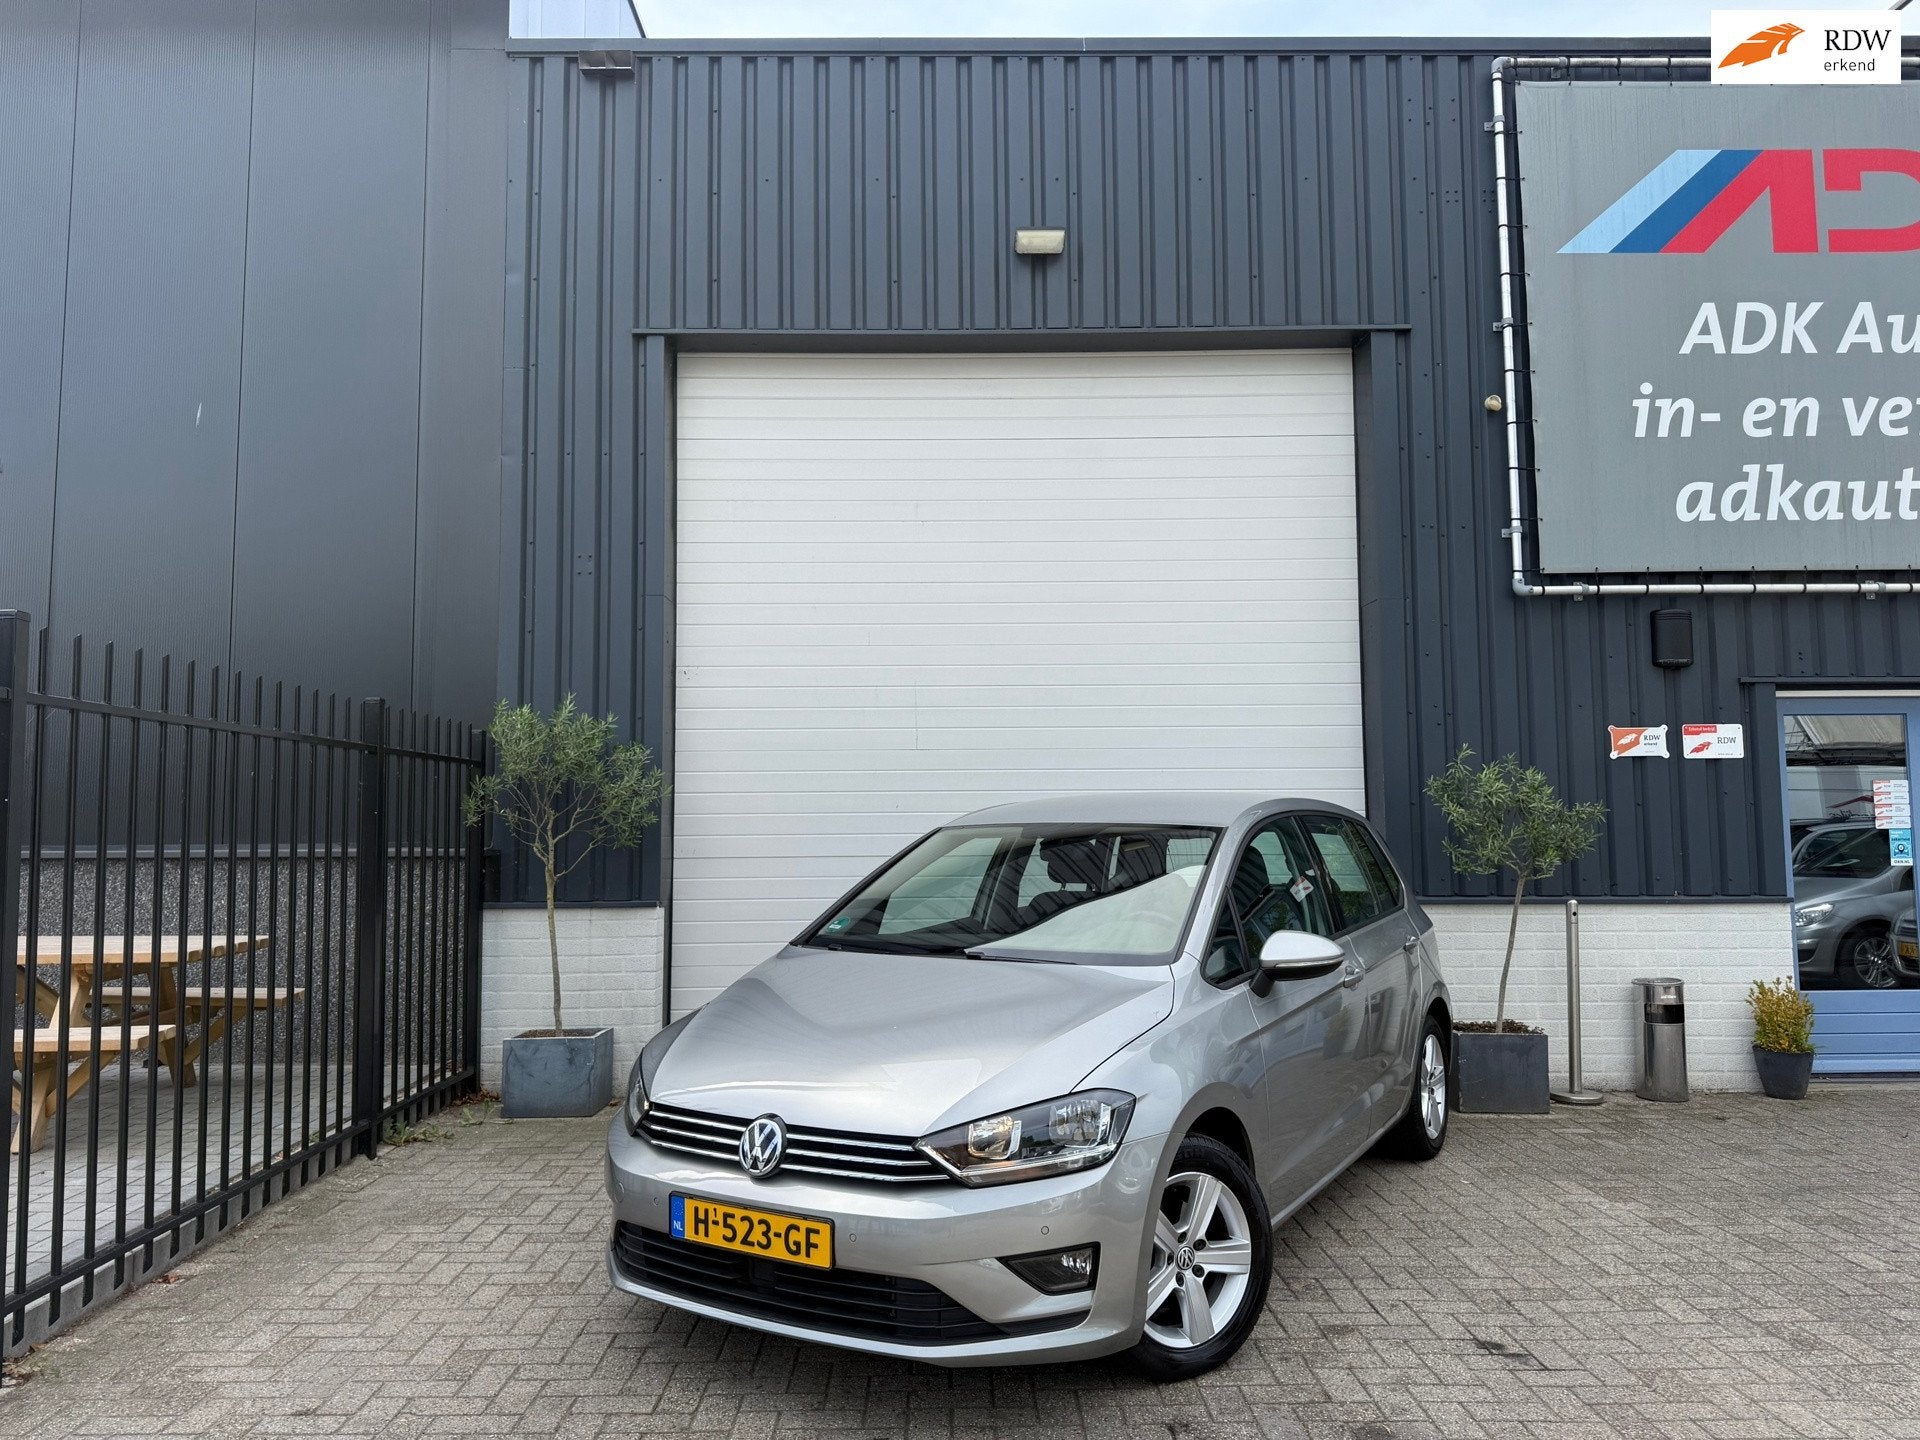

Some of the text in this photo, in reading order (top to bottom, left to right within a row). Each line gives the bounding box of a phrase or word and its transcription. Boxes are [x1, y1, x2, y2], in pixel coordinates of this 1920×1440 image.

[1678, 301, 1920, 354] ADK Au
[1632, 382, 1920, 438] in- en ve
[1675, 463, 1920, 523] adkaut
[1717, 736, 1737, 744] RDW
[673, 1219, 684, 1231] NL
[693, 1205, 821, 1259] H-523-GF
